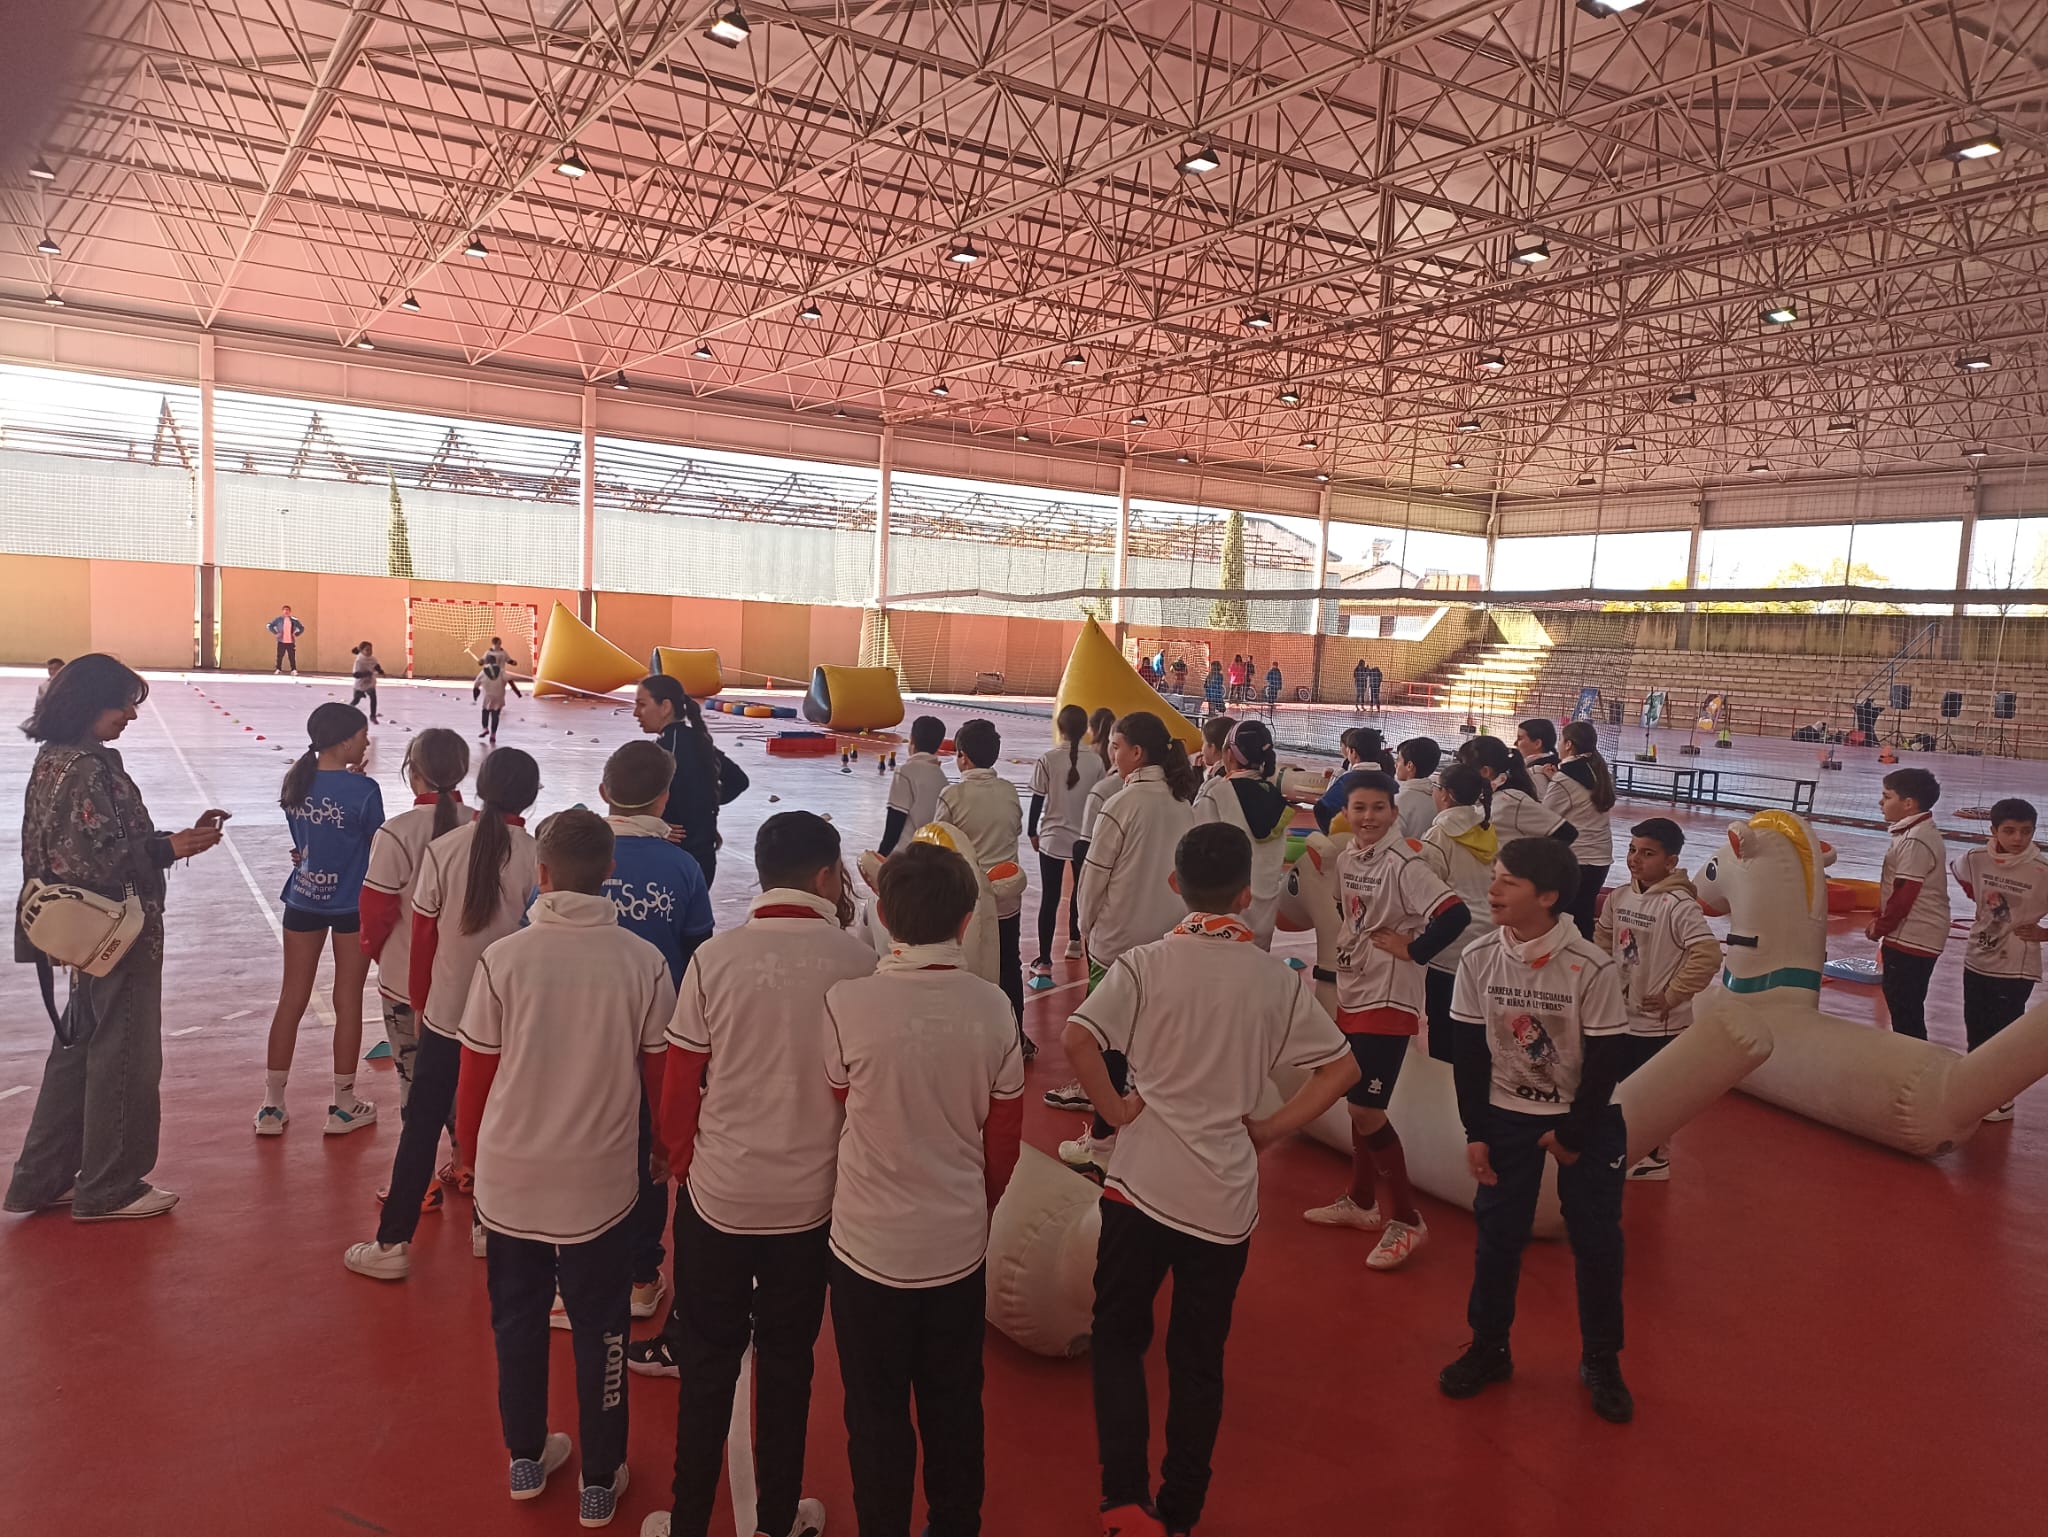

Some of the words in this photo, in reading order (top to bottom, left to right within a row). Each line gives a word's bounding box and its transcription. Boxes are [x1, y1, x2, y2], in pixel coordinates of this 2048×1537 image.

[1487, 985, 1513, 996] CARRERA
[1523, 989, 1532, 998] LA
[1526, 1000, 1532, 1008] A
